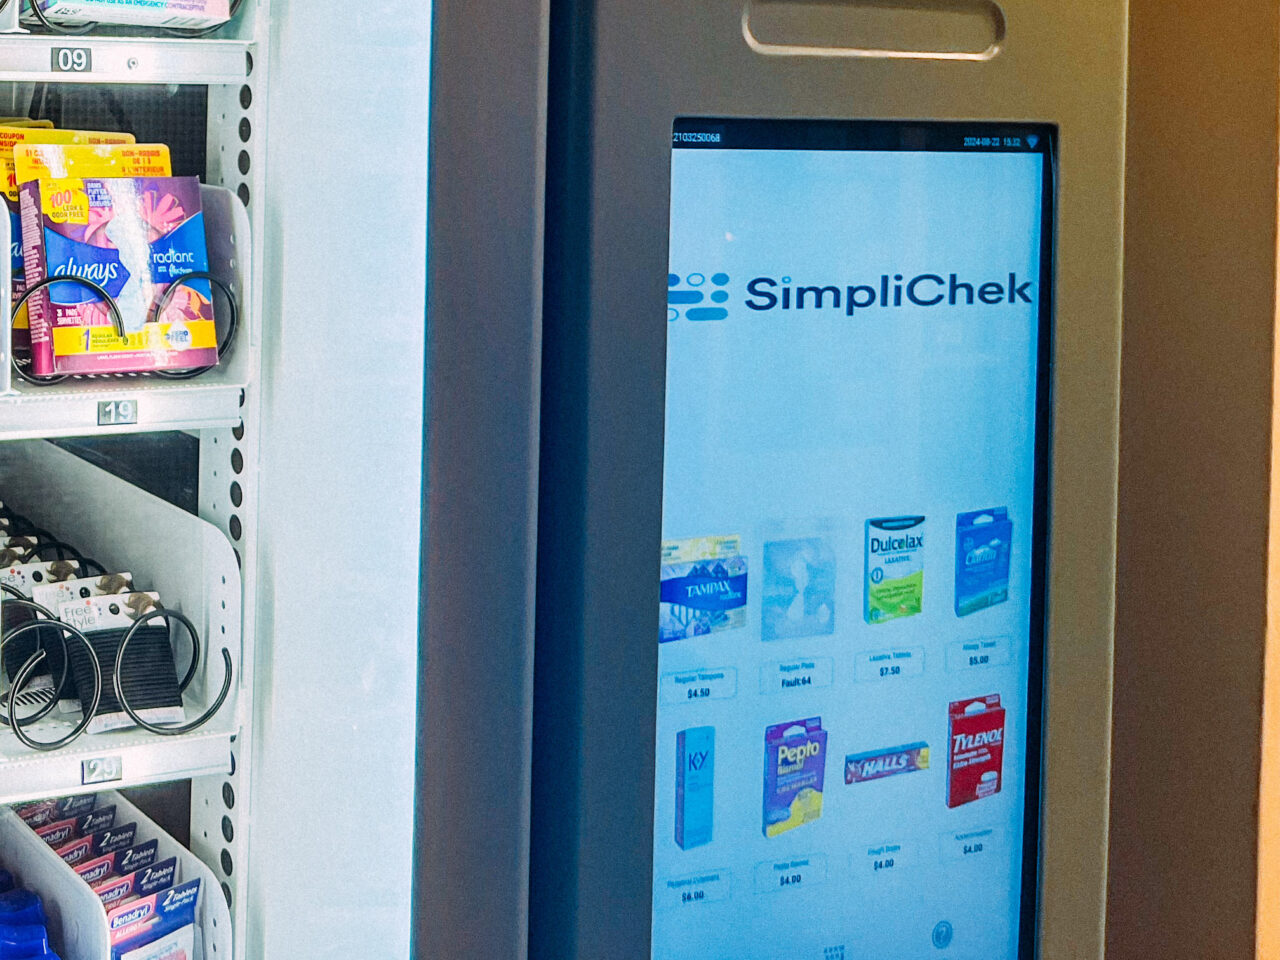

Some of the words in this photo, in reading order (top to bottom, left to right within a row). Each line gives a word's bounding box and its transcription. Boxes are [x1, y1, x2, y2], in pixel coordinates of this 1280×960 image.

[58, 48, 87, 71] 09
[0, 133, 25, 141] COUPON
[153, 248, 194, 264] radiant
[54, 257, 119, 287] always
[745, 272, 1033, 316] SimpliChek
[82, 328, 90, 351] 1
[104, 402, 134, 423] 19
[870, 532, 923, 555] Dulcolax
[685, 578, 731, 599] TAMPAX
[64, 606, 92, 618] Free
[65, 614, 95, 631] Style
[969, 655, 990, 667] $5.00
[879, 665, 901, 678] $7.50
[781, 674, 812, 688] Fault:64
[687, 686, 711, 699] $4.50
[953, 727, 1004, 754] TYLENOL
[777, 740, 821, 765] Pepto
[89, 760, 117, 779] 29
[860, 753, 911, 778] HALLS
[100, 832, 111, 847] 2
[963, 842, 983, 854] $4.00
[122, 849, 133, 865] 2
[132, 847, 155, 861] Tablets
[874, 857, 894, 870] $4.00
[140, 868, 152, 885] 2
[150, 866, 174, 881] Tablets
[780, 873, 802, 886] $4.00
[173, 886, 198, 901] Tablets
[682, 889, 705, 902] $6.00
[113, 904, 149, 927] Benadryl
[115, 922, 142, 938] ALLERGY
